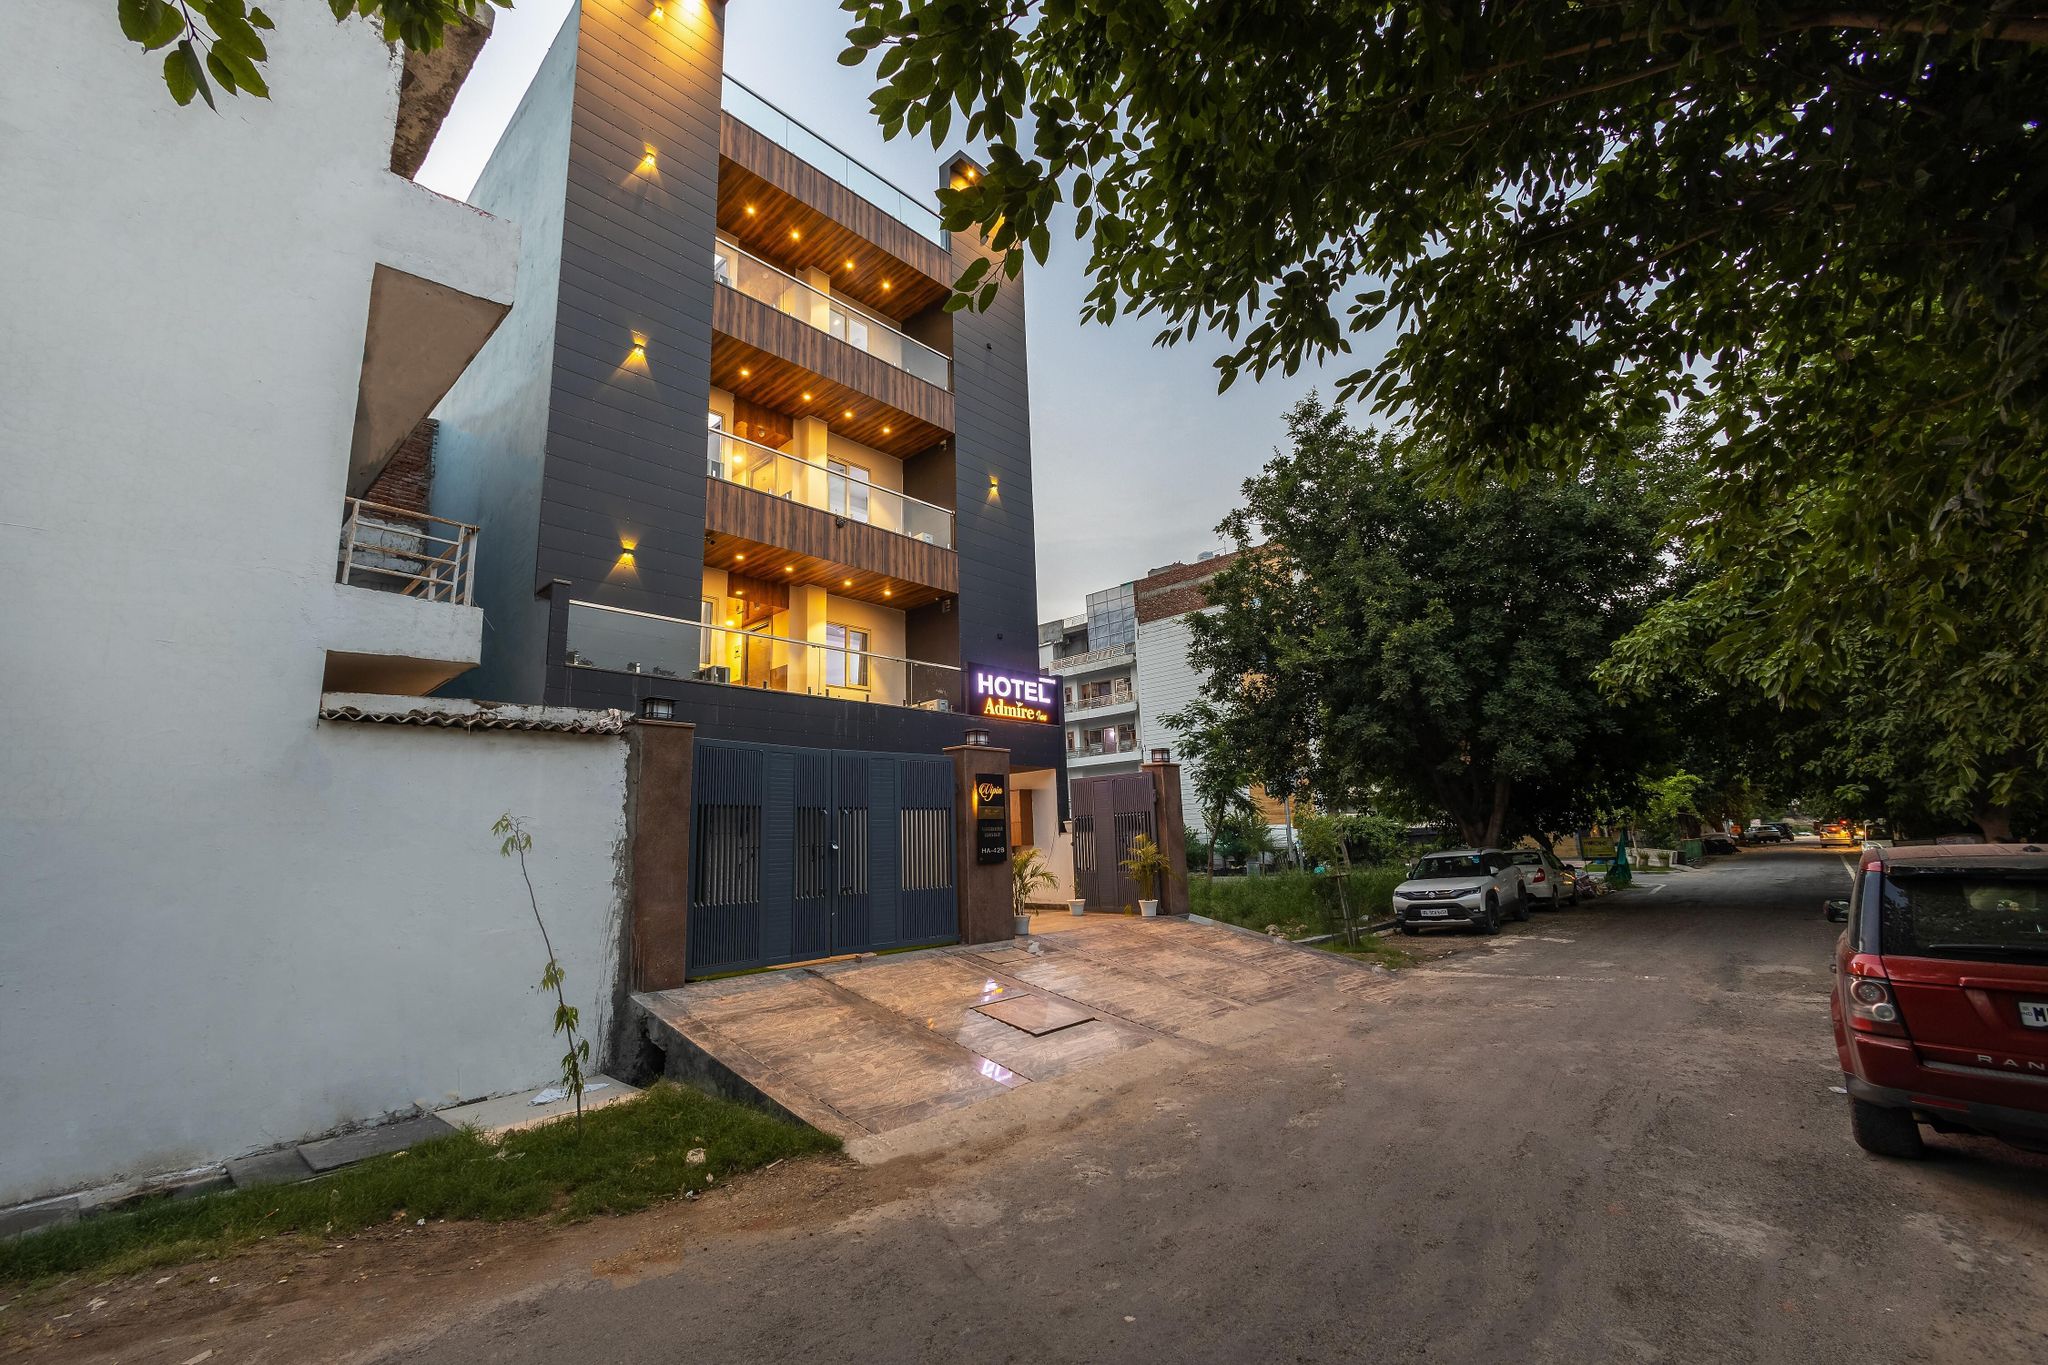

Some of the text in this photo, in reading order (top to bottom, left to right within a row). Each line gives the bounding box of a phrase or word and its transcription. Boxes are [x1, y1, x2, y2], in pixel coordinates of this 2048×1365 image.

[977, 673, 1051, 704] HOTEL
[984, 697, 1035, 720] Admire
[2032, 1007, 2048, 1022] M
